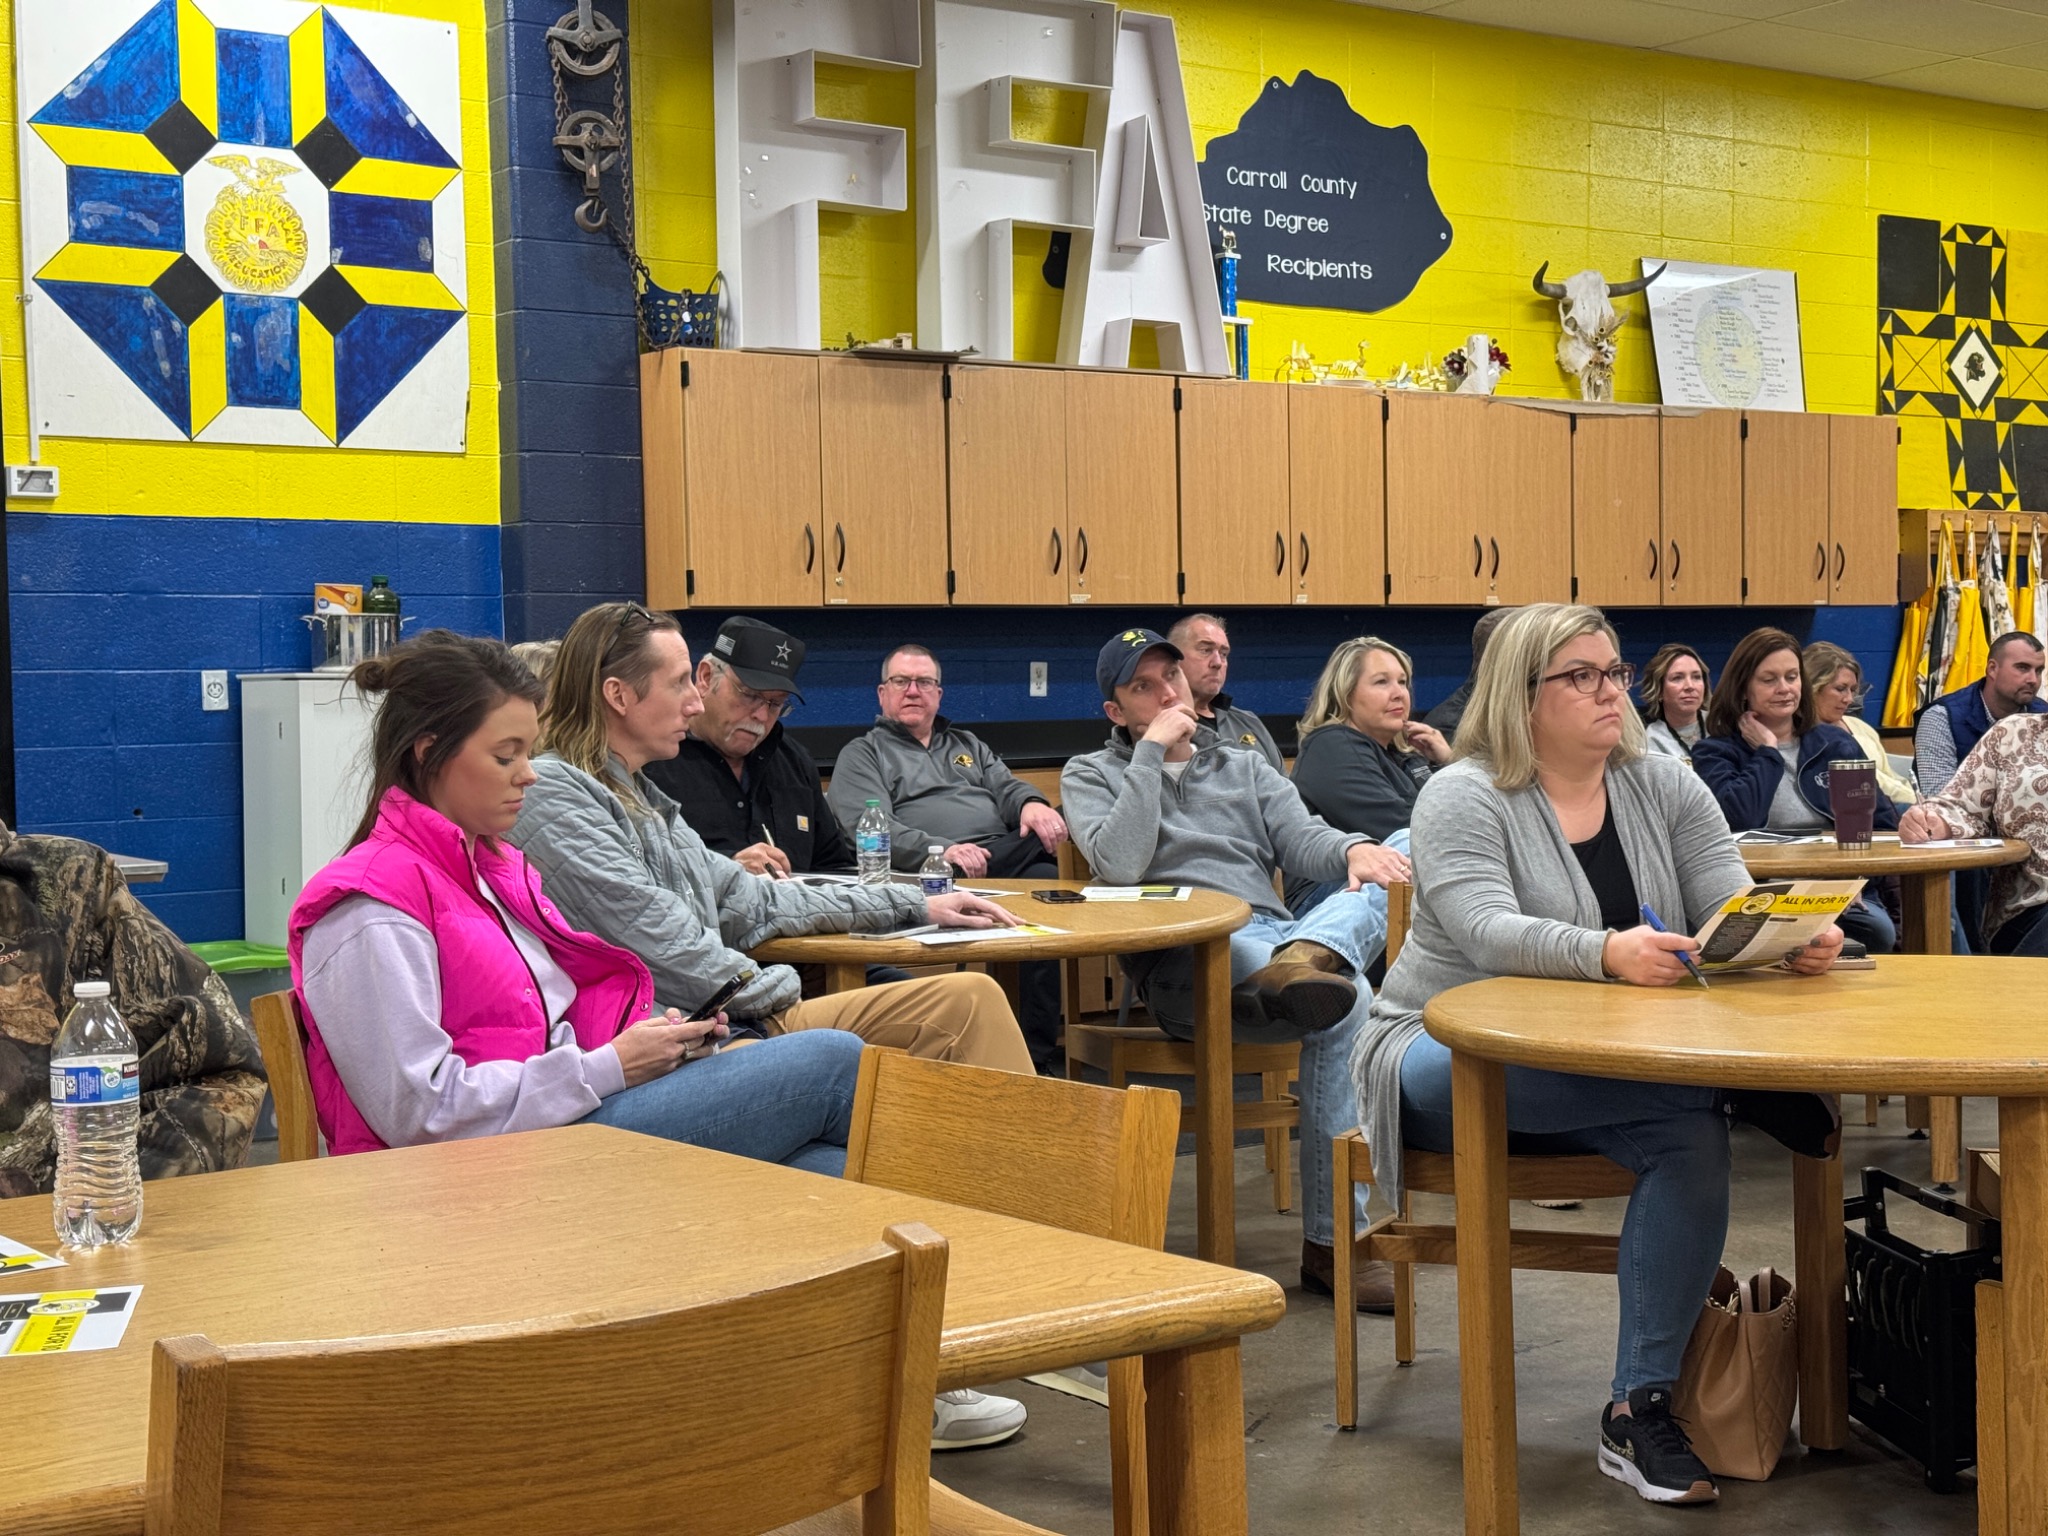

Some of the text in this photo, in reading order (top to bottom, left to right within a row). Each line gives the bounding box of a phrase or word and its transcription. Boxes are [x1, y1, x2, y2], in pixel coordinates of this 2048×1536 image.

[713, 0, 1231, 375] FFA
[1226, 166, 1357, 199] Carroll County
[239, 215, 280, 238] FFA
[1203, 204, 1329, 234] State Degree
[1267, 254, 1373, 280] Recipients
[1780, 896, 1850, 905] ALL IN FOR 10
